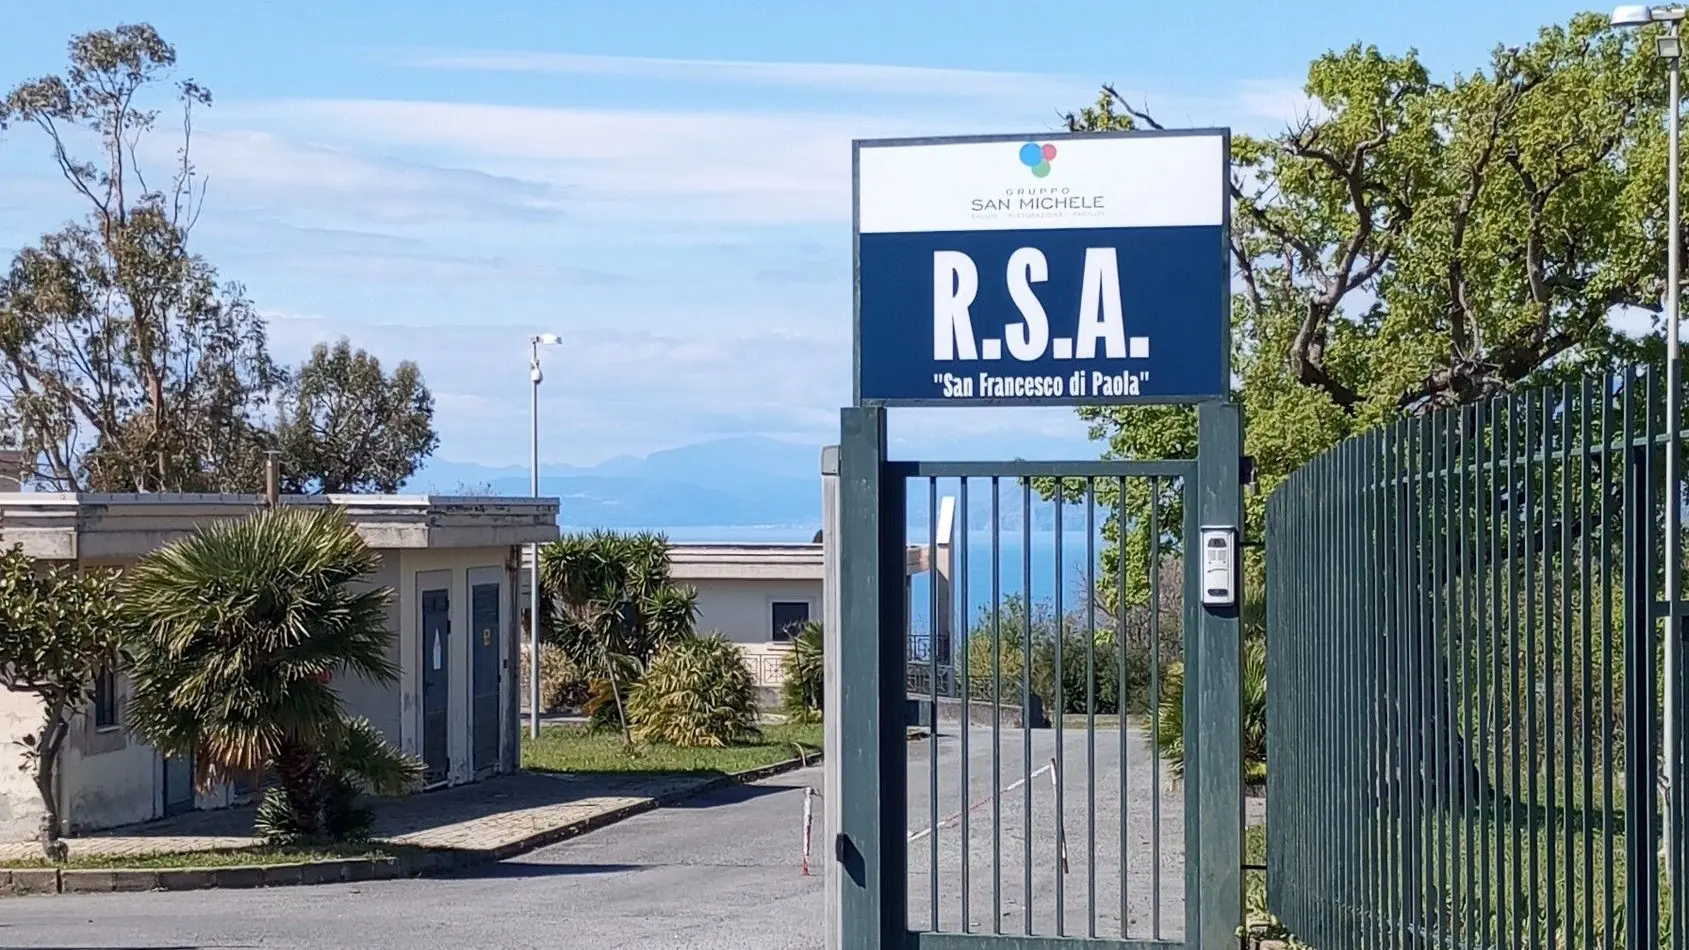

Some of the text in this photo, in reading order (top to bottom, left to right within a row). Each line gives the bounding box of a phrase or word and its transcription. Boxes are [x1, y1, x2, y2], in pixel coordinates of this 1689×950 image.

[1005, 187, 1071, 196] GRUPPO
[971, 196, 1105, 211] SAN MICHELE
[933, 246, 1150, 362] R.S.A.
[934, 370, 1150, 398] "San Francesco di Paola"
